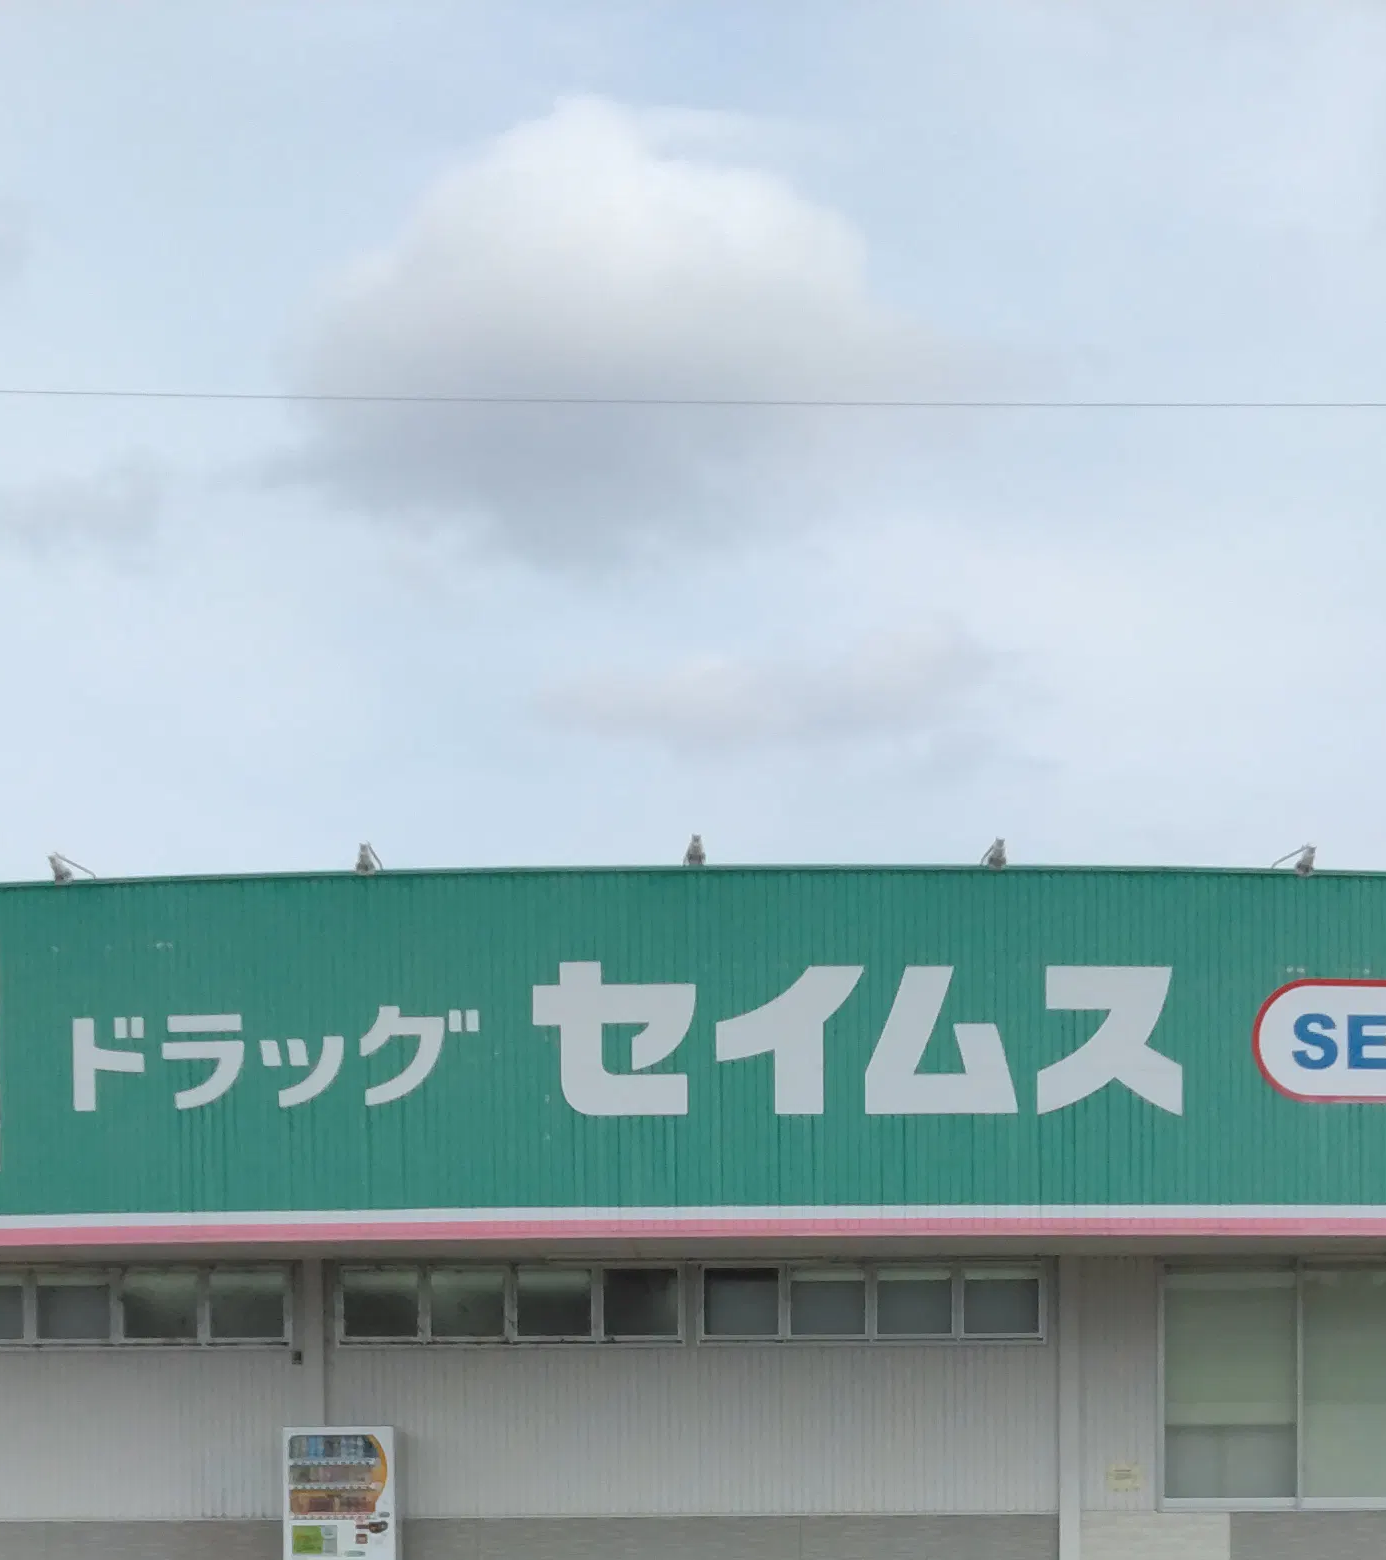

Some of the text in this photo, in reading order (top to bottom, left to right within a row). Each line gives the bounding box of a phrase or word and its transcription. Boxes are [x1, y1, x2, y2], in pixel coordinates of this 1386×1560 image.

[72, 961, 1183, 1117] ドラッグ セイムス
